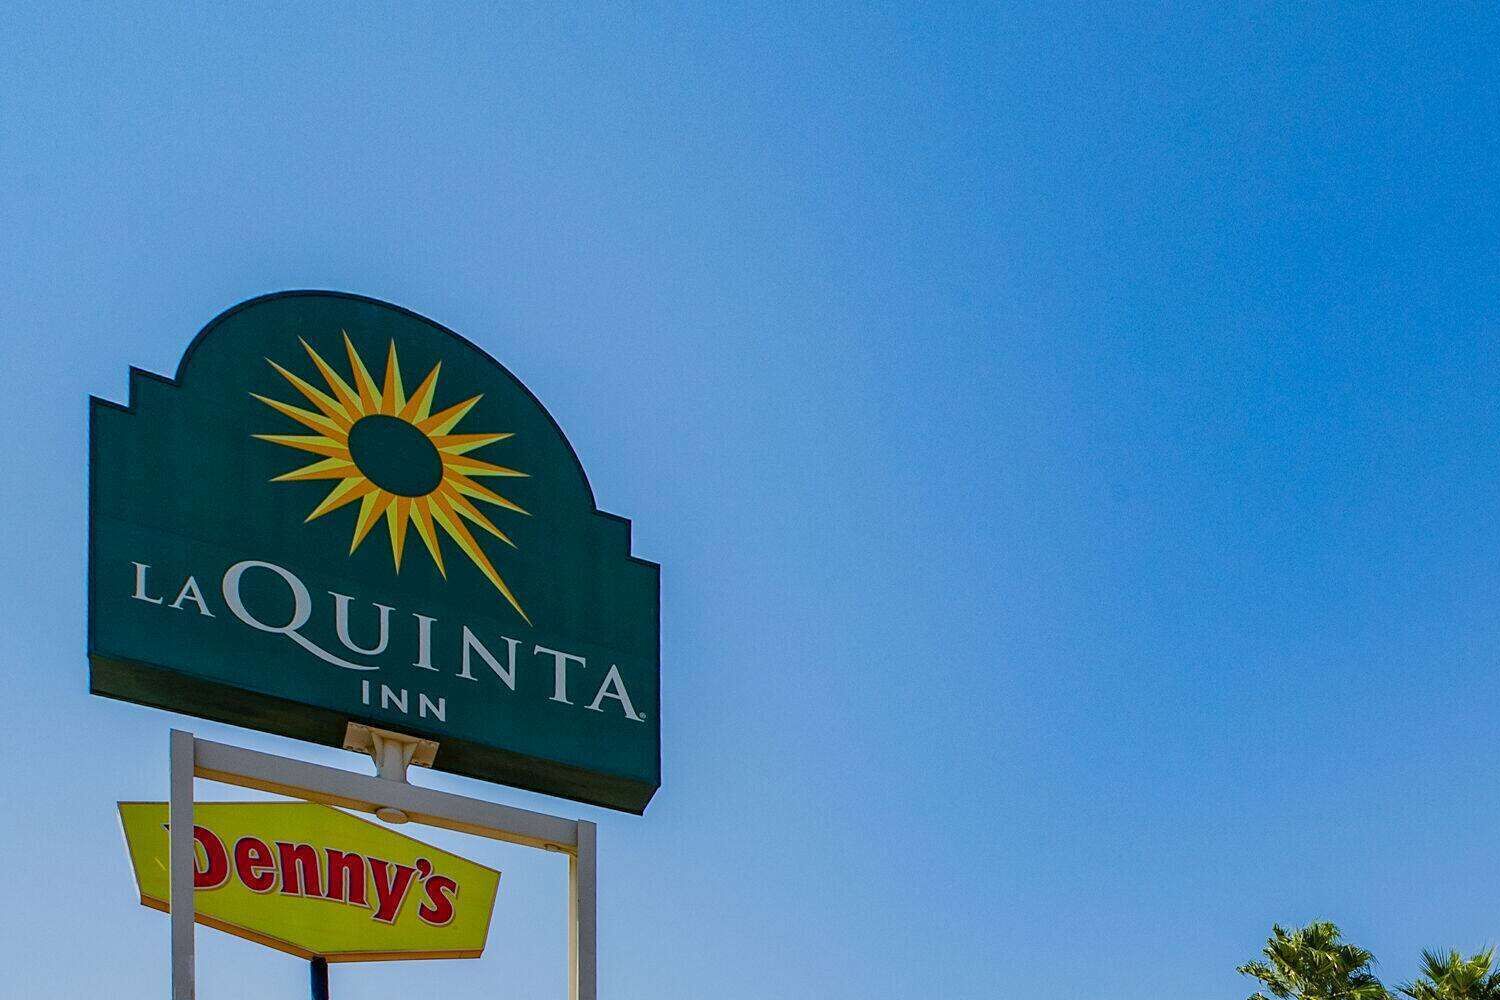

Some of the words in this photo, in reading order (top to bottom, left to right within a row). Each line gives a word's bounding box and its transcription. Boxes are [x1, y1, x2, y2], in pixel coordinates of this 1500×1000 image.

[131, 561, 216, 618] LA
[222, 560, 645, 723] QUINTA
[362, 680, 446, 722] INN
